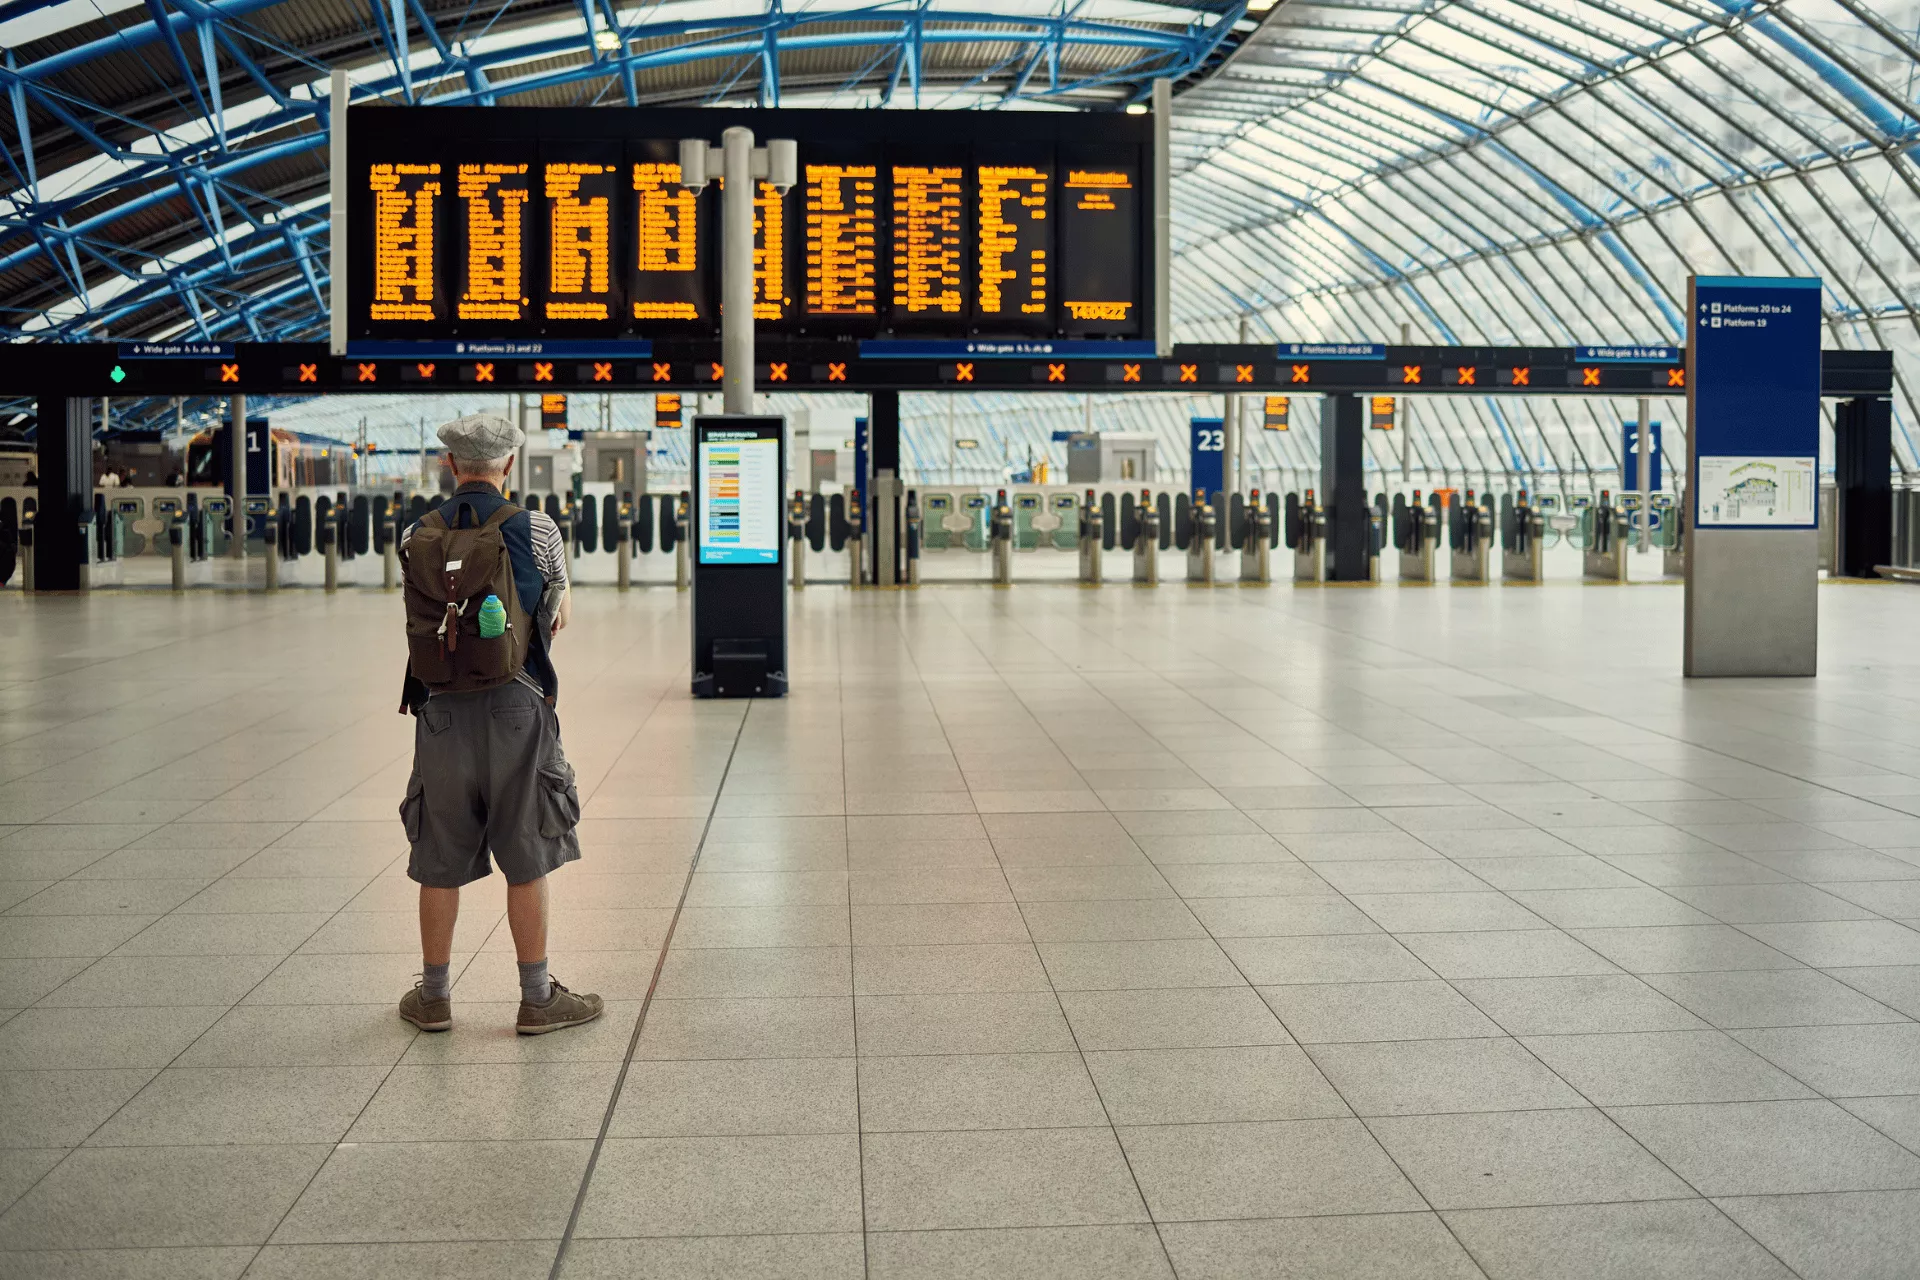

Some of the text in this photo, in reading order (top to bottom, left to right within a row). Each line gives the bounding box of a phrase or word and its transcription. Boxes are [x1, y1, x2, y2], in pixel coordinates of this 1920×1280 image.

[1723, 303, 1791, 314] Platforms 20 to 24
[1723, 317, 1767, 328] Platform 19
[143, 345, 181, 355] Wide gate
[469, 344, 505, 354] Platforms
[517, 344, 531, 354] and
[1302, 345, 1336, 354] Platforms
[1197, 429, 1225, 451] 23
